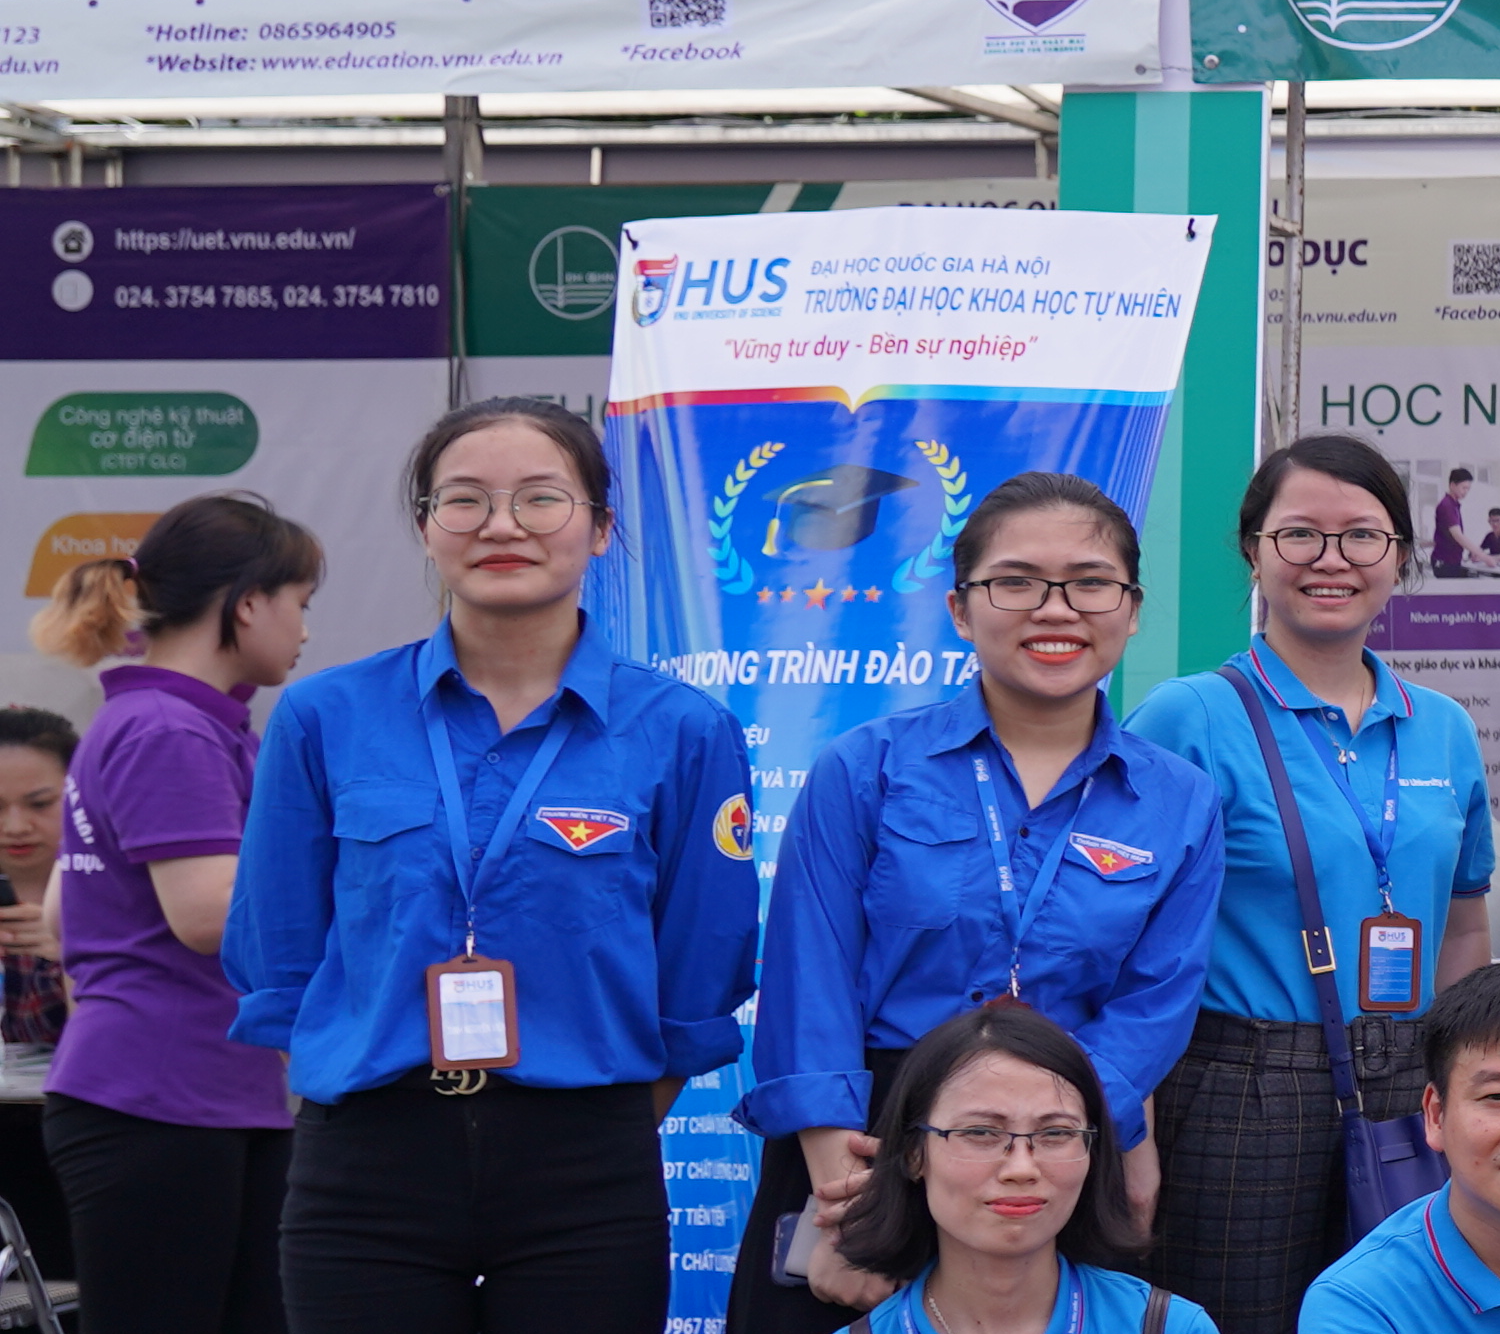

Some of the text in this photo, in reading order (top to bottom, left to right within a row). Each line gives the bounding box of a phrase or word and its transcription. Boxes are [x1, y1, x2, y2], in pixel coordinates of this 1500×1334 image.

[258, 20, 397, 41] 0865964905
[261, 47, 563, 72] www.education.vnu.edu.vn
[115, 227, 356, 254] https://uet.vnu.edu.vn/
[677, 257, 791, 305] HUS
[805, 283, 877, 314] TRƯỜNG
[882, 289, 917, 317] ĐẠI
[920, 287, 965, 317] HỌC
[969, 288, 1027, 314] KHOA
[1032, 290, 1079, 318] HỌC
[1084, 291, 1117, 322] TỰ
[1117, 287, 1181, 318] NHIÊN
[787, 339, 807, 357] tư
[814, 338, 849, 361] duy
[869, 333, 910, 356] Bền
[916, 338, 942, 359] sự
[1322, 382, 1442, 434] HỌC
